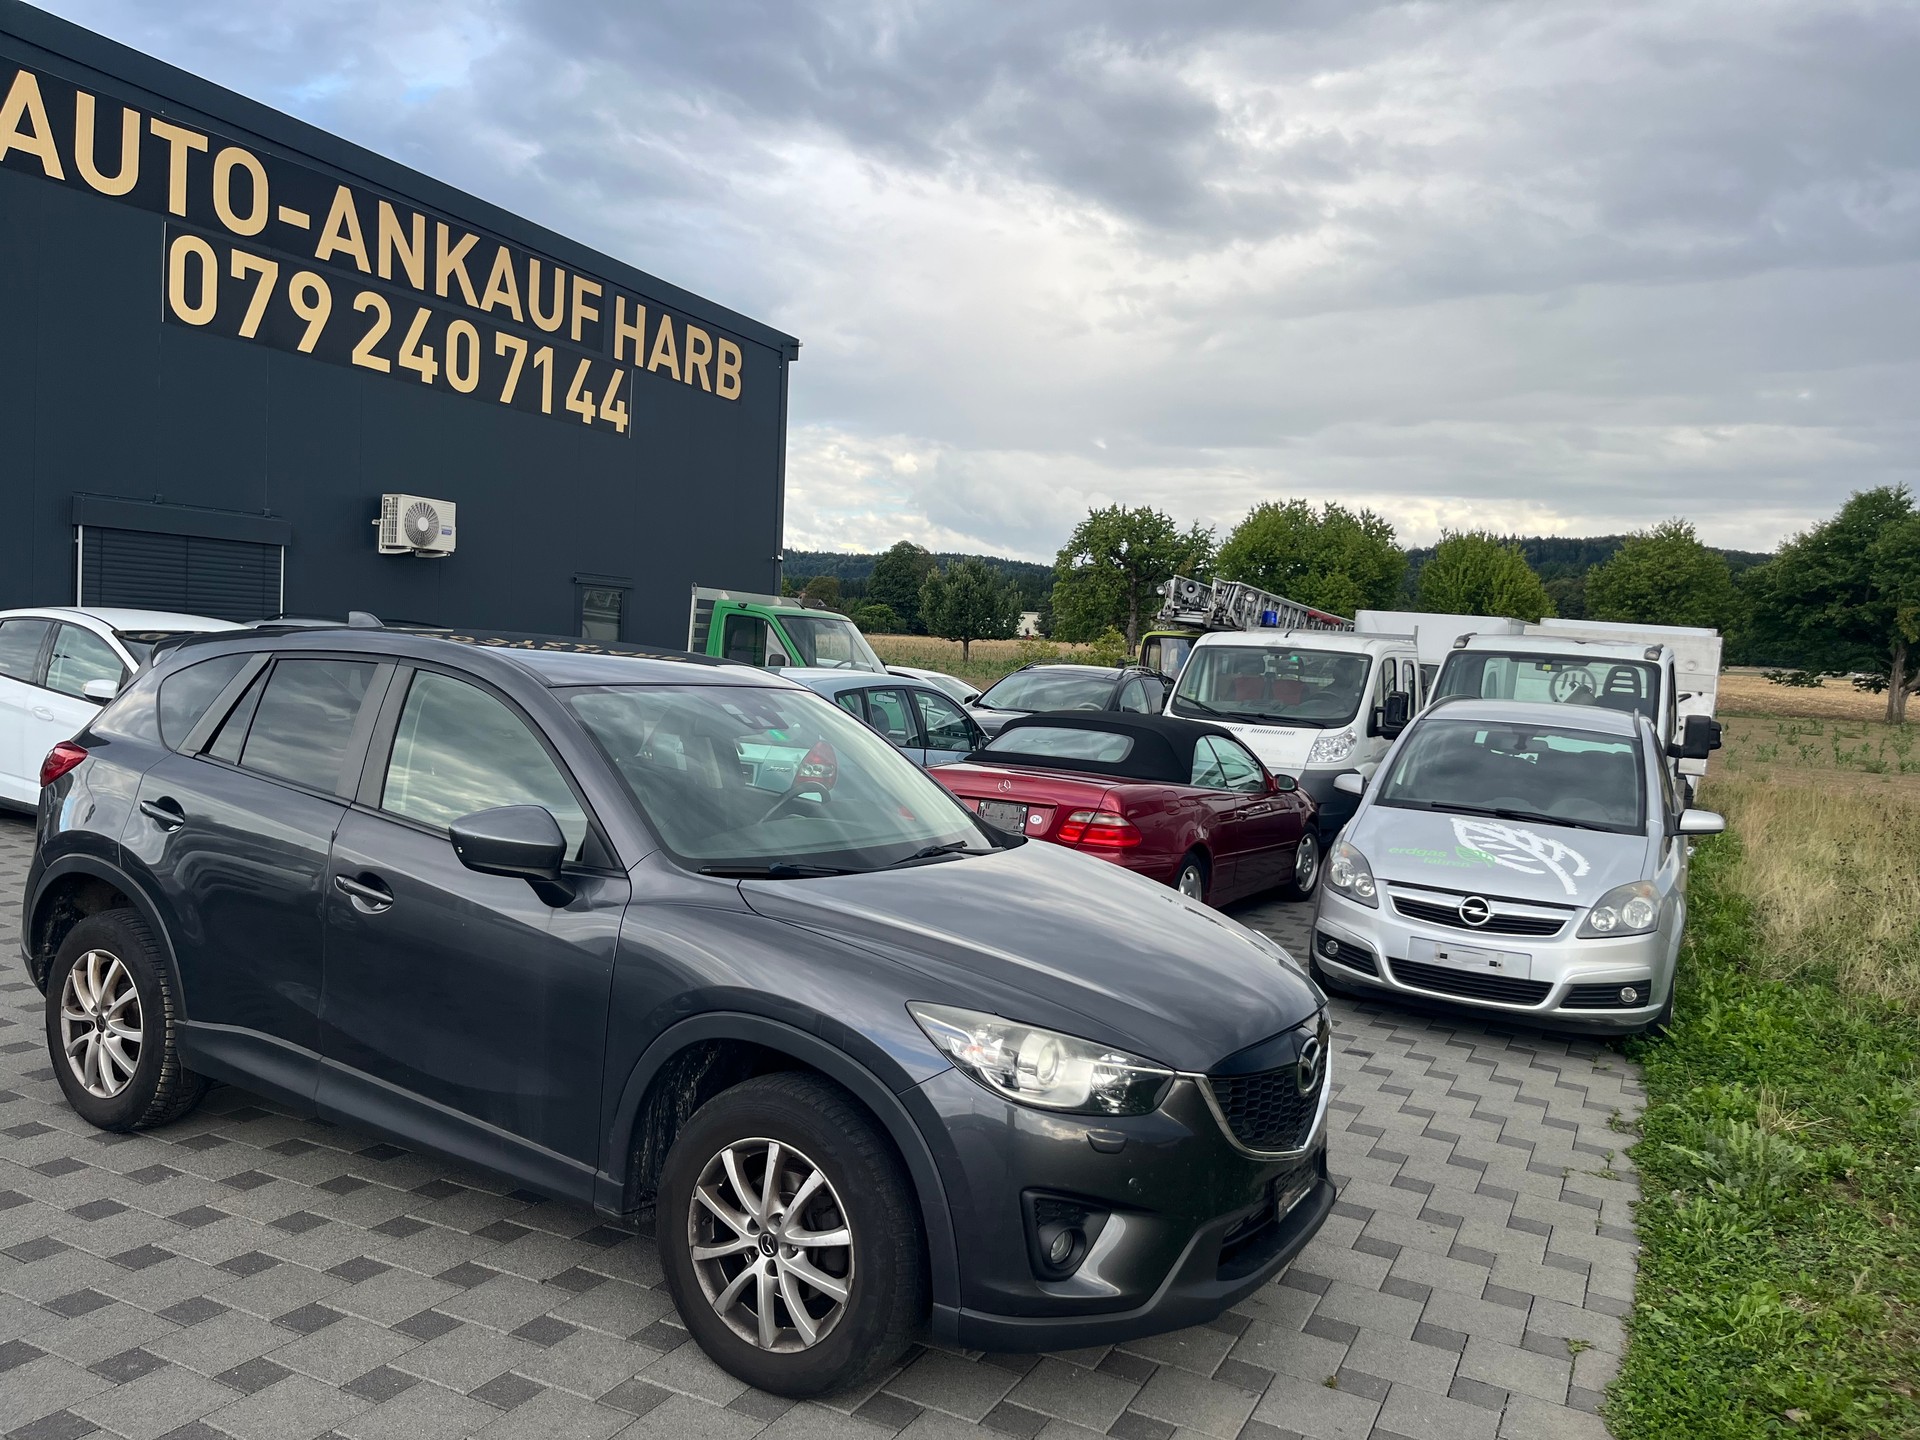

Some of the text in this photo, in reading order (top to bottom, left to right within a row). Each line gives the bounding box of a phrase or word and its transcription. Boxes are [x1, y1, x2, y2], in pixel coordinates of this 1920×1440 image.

[0, 69, 743, 401] AUTO-ANKAUF HARB
[168, 235, 629, 433] 079 240 7144
[1387, 847, 1448, 858] erdgas
